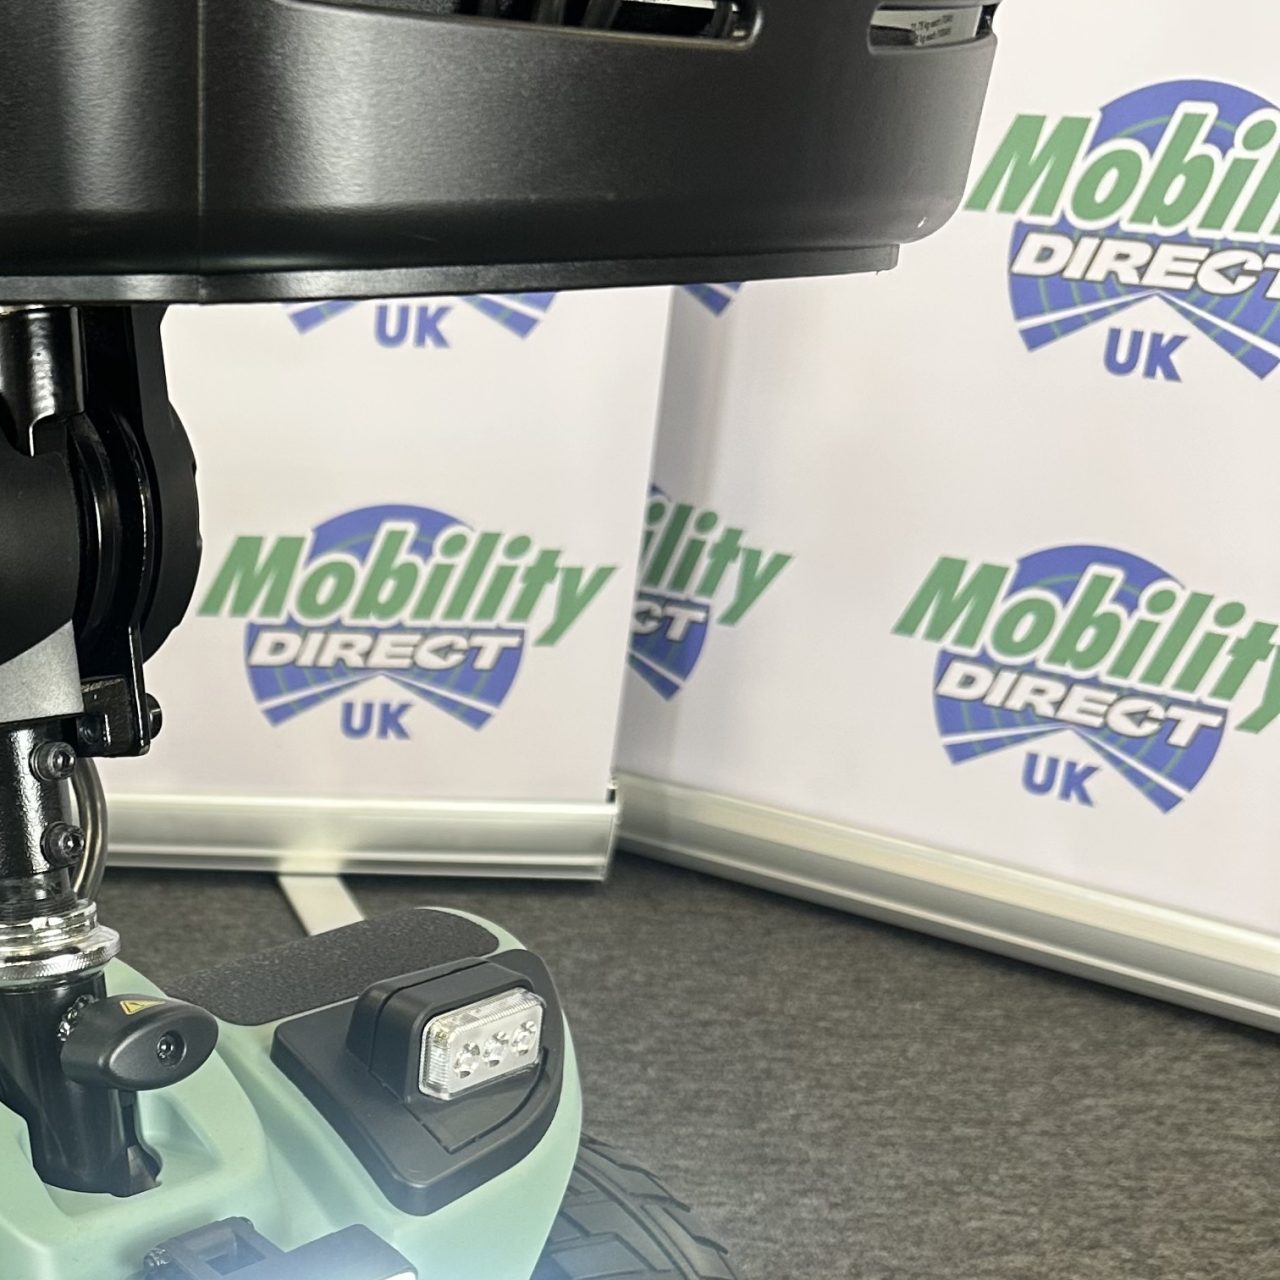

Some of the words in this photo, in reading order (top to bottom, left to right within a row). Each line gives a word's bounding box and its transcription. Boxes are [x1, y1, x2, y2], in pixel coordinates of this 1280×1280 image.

[963, 112, 1280, 236] Mobil
[374, 304, 453, 349] UK
[1103, 326, 1189, 383] UK
[196, 528, 618, 648] Mobility
[248, 631, 523, 670] DIRECT
[340, 701, 415, 741] UK
[934, 658, 1224, 748] DIRECT
[1021, 751, 1100, 807] UK
